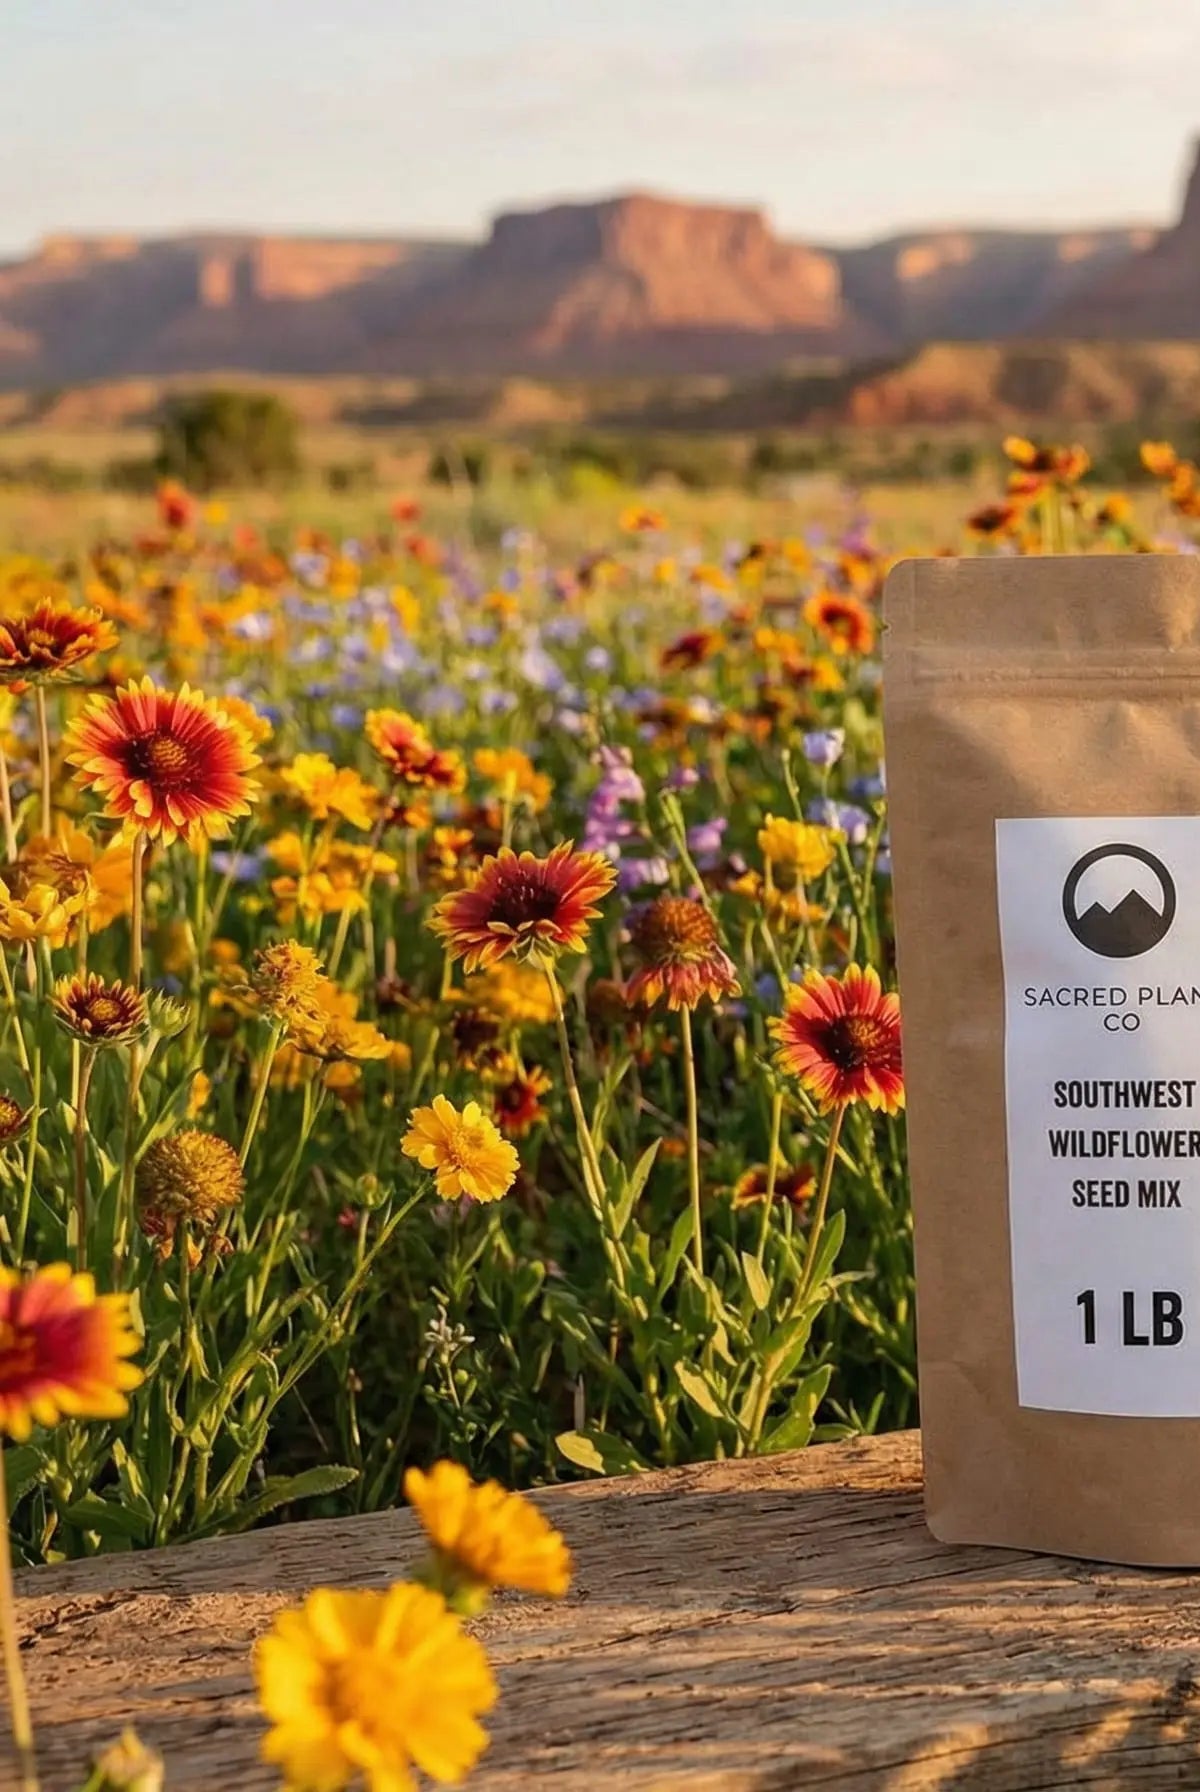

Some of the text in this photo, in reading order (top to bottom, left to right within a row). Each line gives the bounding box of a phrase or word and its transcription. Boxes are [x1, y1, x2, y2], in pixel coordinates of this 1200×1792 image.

[1023, 987, 1128, 1008] SACRED
[1103, 1012, 1141, 1032] CO
[1053, 1079, 1197, 1109] SOUTHWEST
[1071, 1178, 1182, 1209] SEED MIX
[1076, 1288, 1184, 1347] 1 LB
